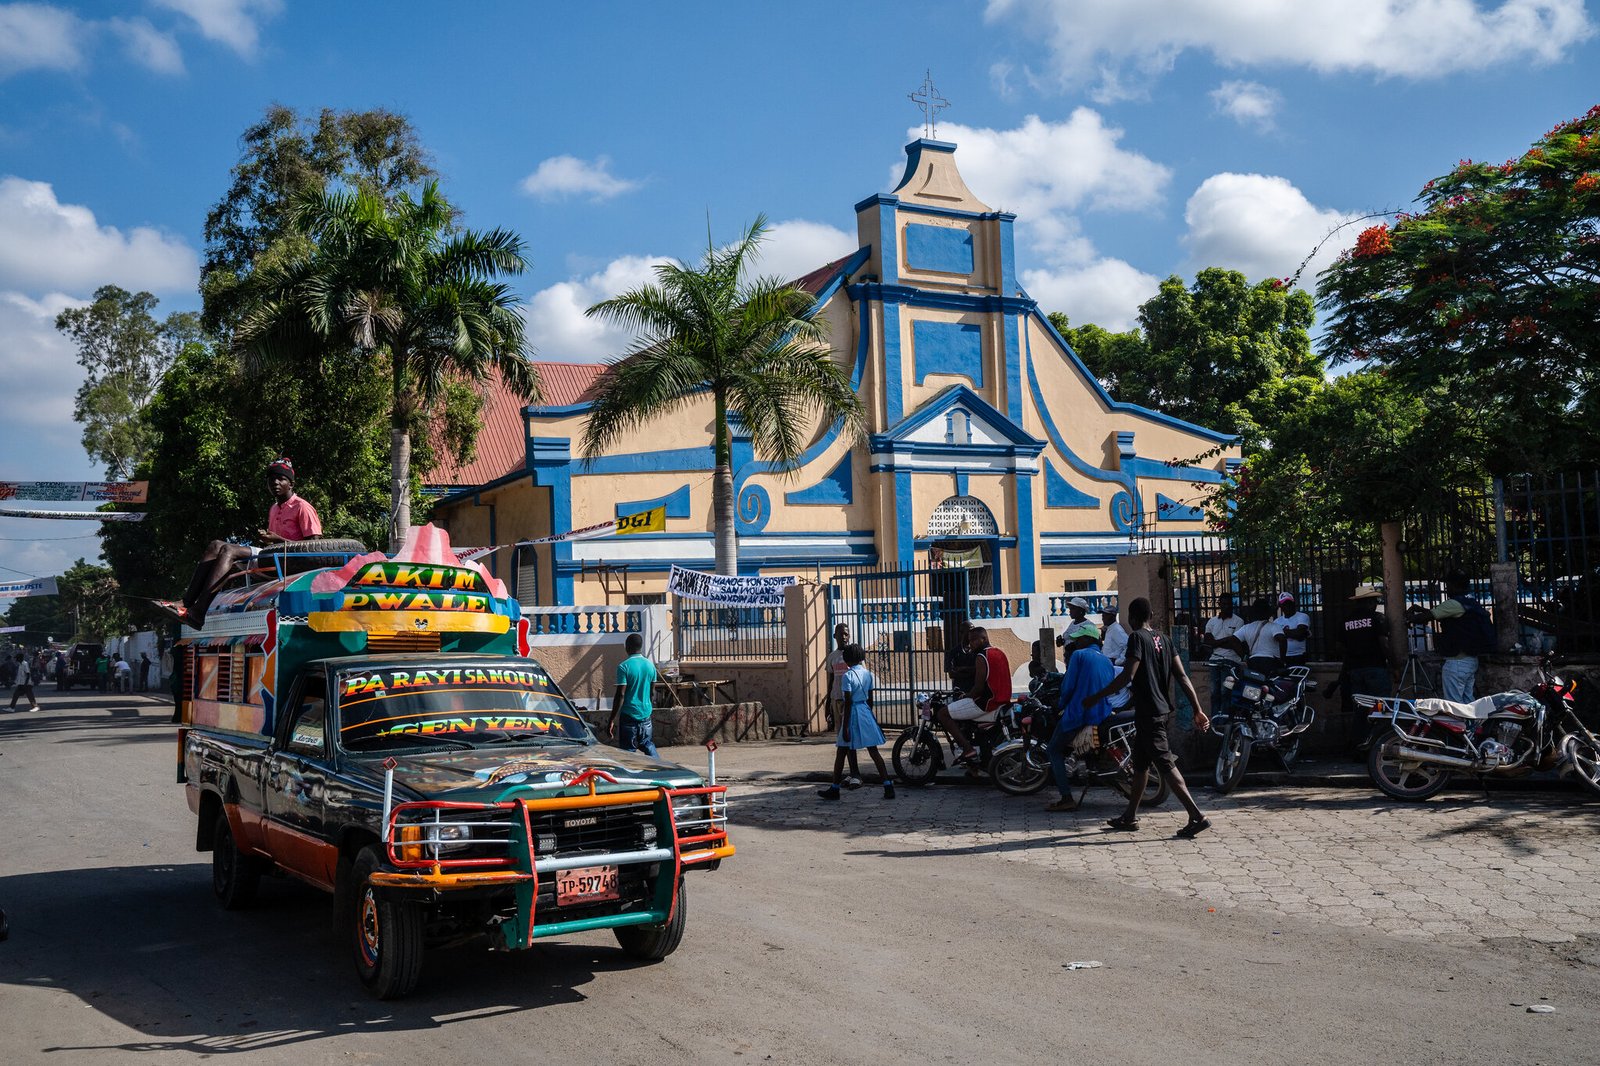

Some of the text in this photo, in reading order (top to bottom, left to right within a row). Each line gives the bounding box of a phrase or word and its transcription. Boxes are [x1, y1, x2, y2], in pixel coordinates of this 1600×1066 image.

[616, 511, 653, 530] DGI
[712, 576, 744, 587] MANDE
[746, 578, 762, 587] YON
[720, 586, 775, 595] SAN VYOLANS
[340, 592, 488, 613] PWALE
[709, 592, 727, 602] SAN
[747, 594, 759, 604] AK
[1344, 618, 1372, 631] PRESSE
[345, 674, 389, 697] PA
[565, 817, 597, 828] TOYOTA
